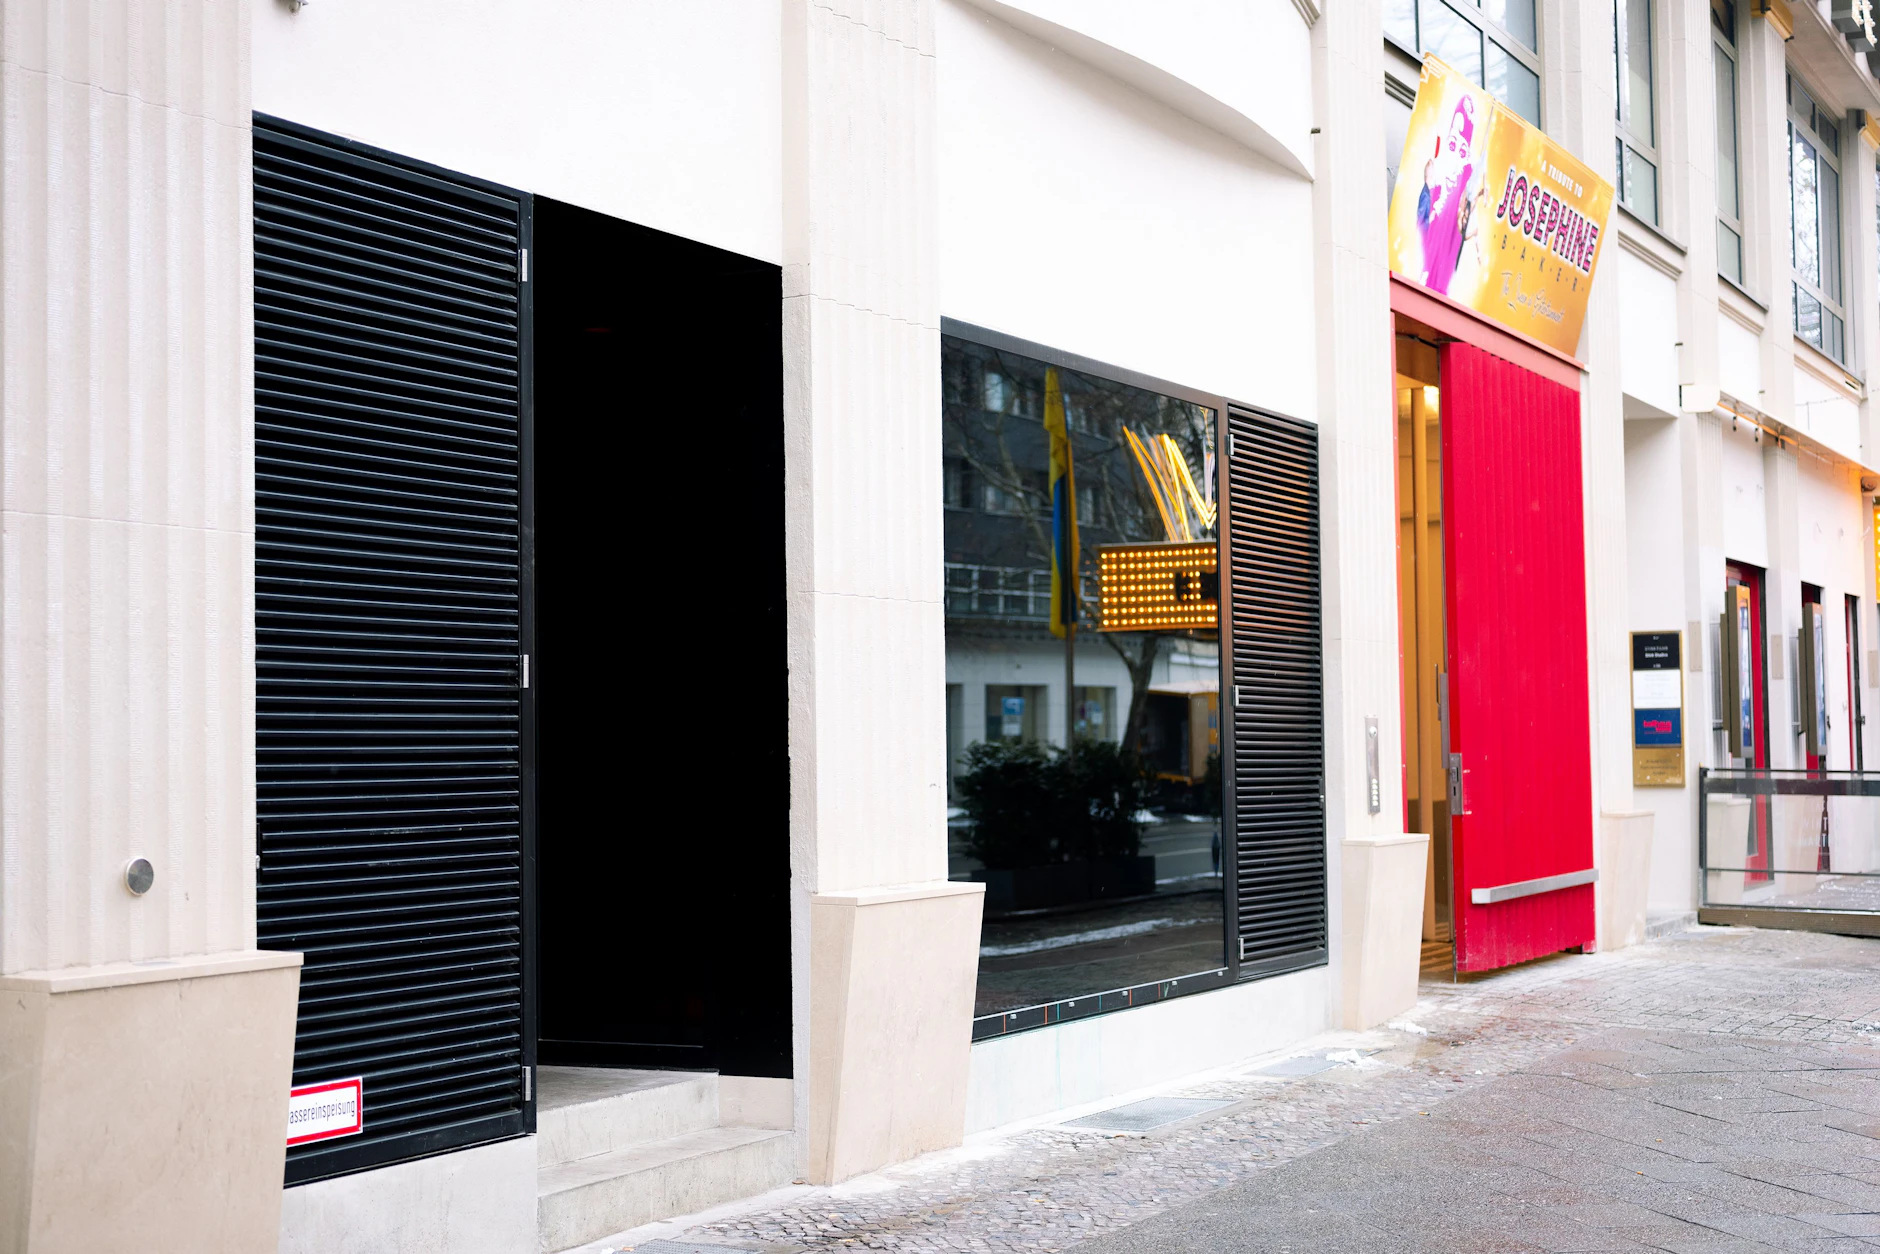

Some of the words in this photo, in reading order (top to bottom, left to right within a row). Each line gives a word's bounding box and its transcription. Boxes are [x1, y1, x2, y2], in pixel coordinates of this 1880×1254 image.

[1541, 159, 1547, 174] A
[1547, 163, 1574, 192] TRIBUTE
[1573, 182, 1583, 199] TO
[1497, 168, 1599, 273] JOSEPHINE
[289, 1098, 355, 1124] assereinspeisung
